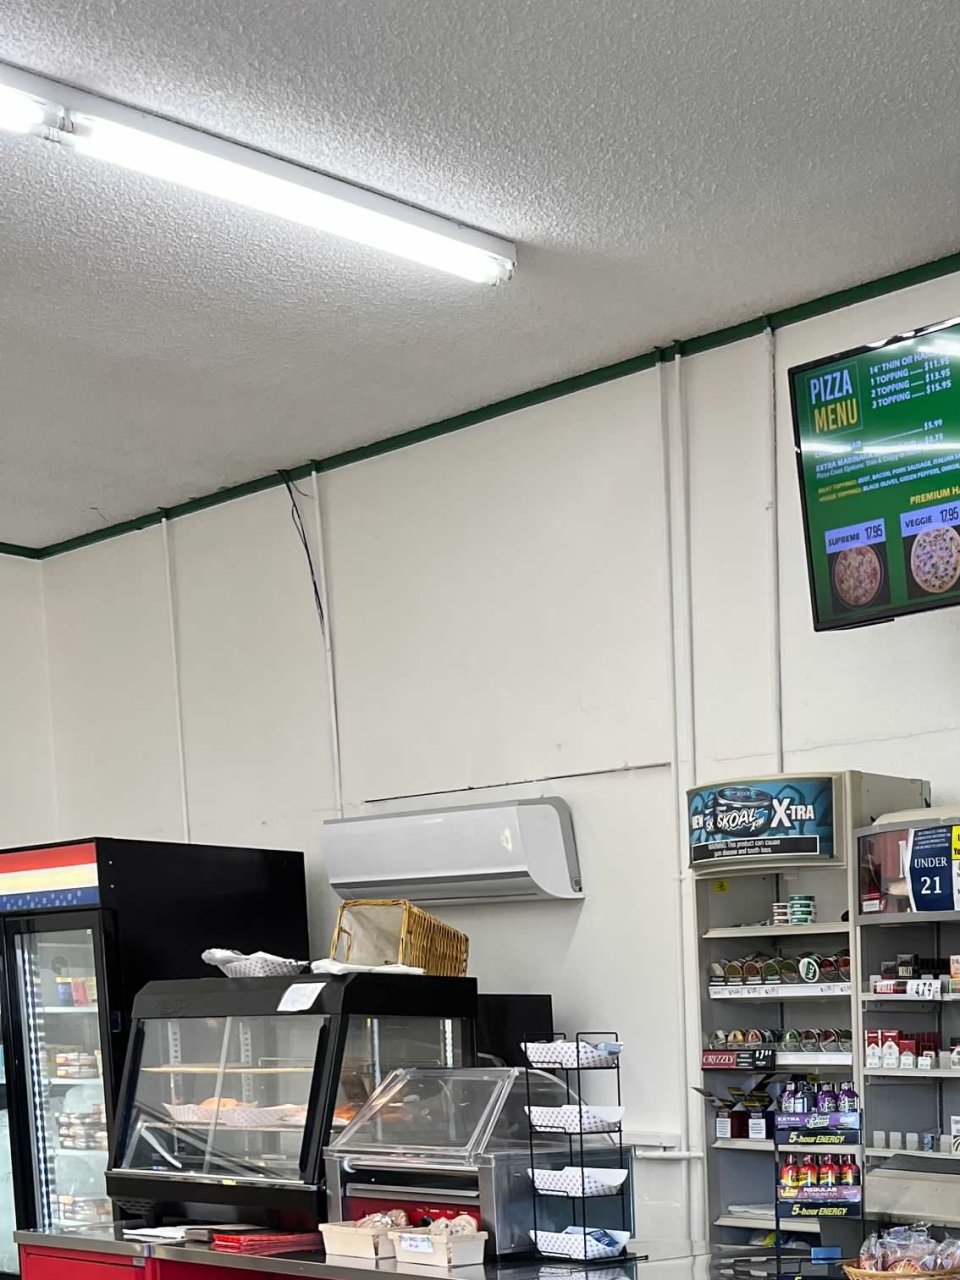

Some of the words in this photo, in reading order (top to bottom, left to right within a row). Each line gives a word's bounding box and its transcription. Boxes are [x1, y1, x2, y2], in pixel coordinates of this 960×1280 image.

[810, 368, 852, 405] PIZZA
[872, 400, 877, 409] 3
[877, 391, 910, 408] TOPPING
[926, 378, 951, 394] $15.95
[814, 397, 858, 433] MENU
[910, 487, 950, 504] PREMIUM
[905, 515, 932, 529] VEGGIE
[940, 506, 958, 523] 17.95
[828, 532, 859, 546] SUPREME
[865, 524, 882, 539] 17.95
[717, 807, 756, 828] SKOAL
[770, 798, 815, 828] X-TRA
[914, 857, 948, 868] UNDER
[921, 876, 942, 894] 21
[703, 1053, 735, 1064] GRIZZLY
[789, 1131, 816, 1144] 5-hour
[816, 1135, 845, 1144] ENERGY
[791, 1204, 818, 1215] 5-hour
[818, 1207, 848, 1216] ENERGY
